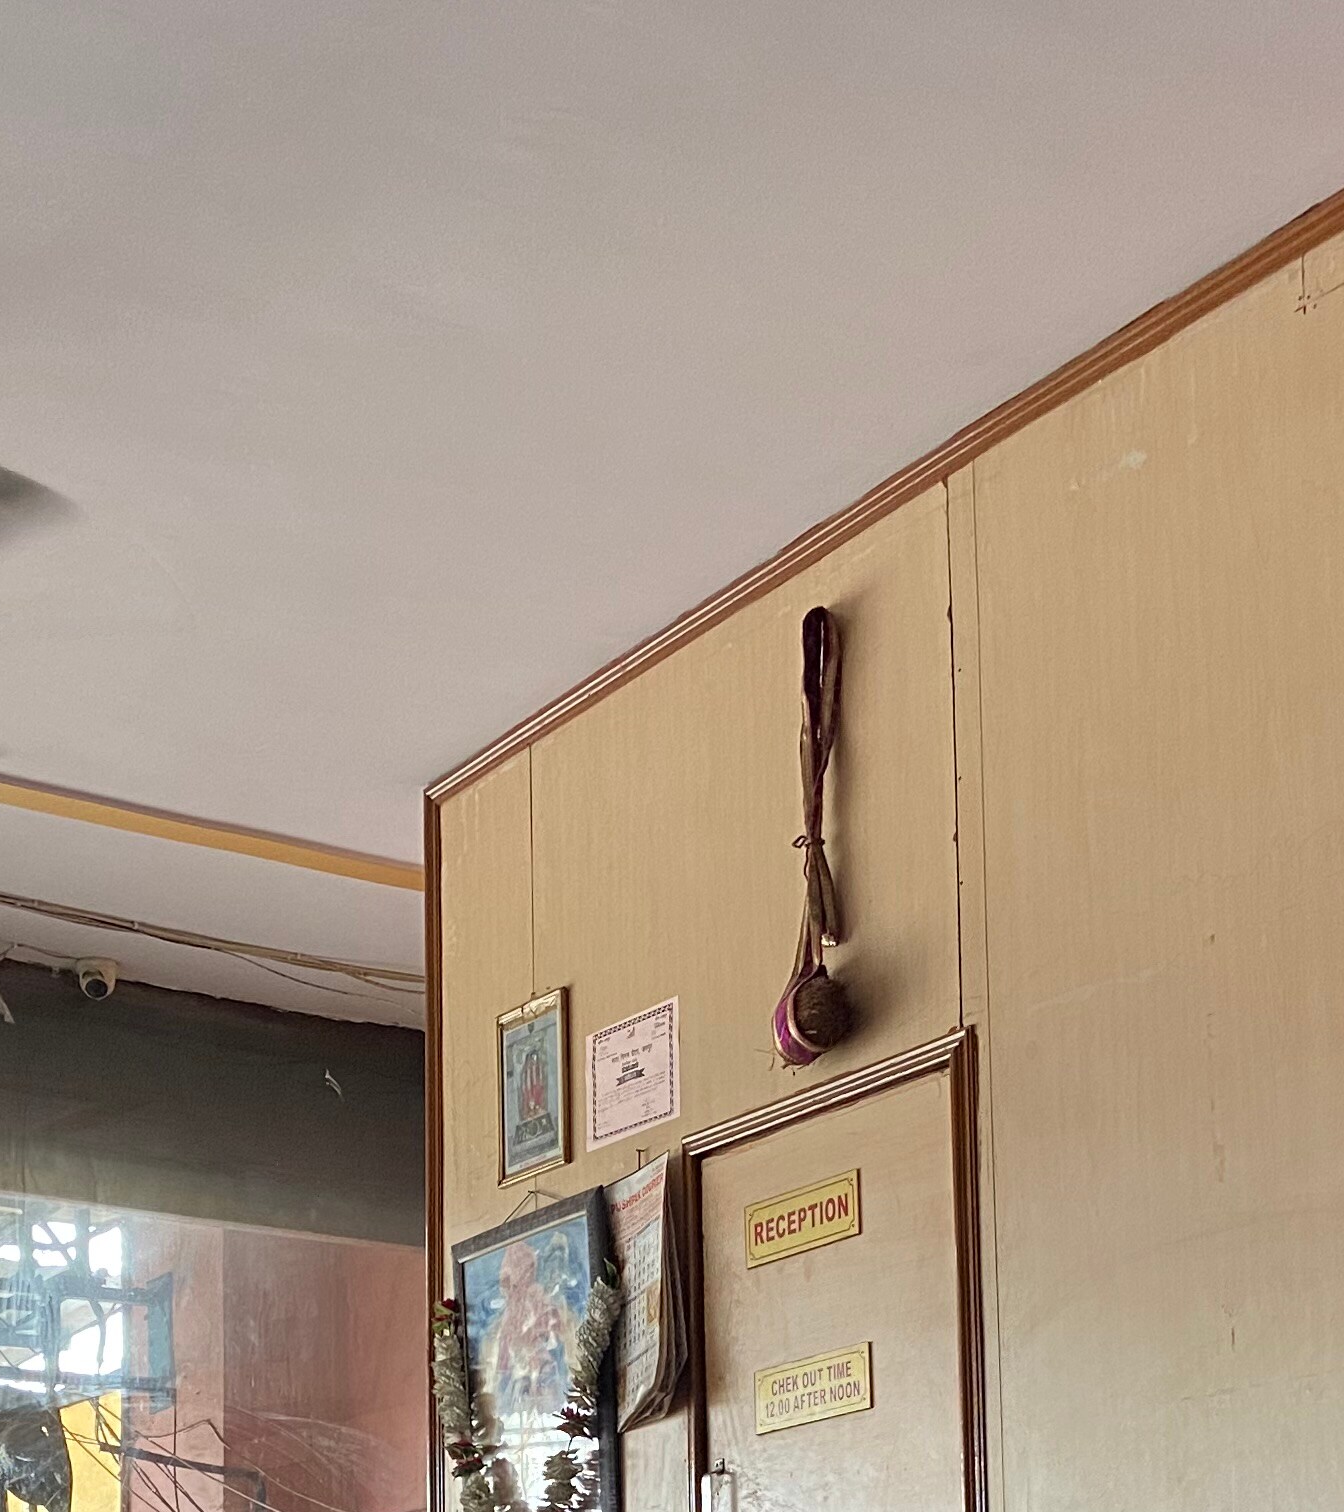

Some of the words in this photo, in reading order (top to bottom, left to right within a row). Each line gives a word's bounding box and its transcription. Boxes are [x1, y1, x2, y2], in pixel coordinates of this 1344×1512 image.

[754, 1193, 849, 1246] RECEPTION
[771, 1375, 799, 1396] CHEK
[802, 1368, 823, 1388] OUT
[827, 1361, 851, 1382] TIME
[793, 1389, 826, 1411] AFTER
[830, 1381, 860, 1403] NOON
